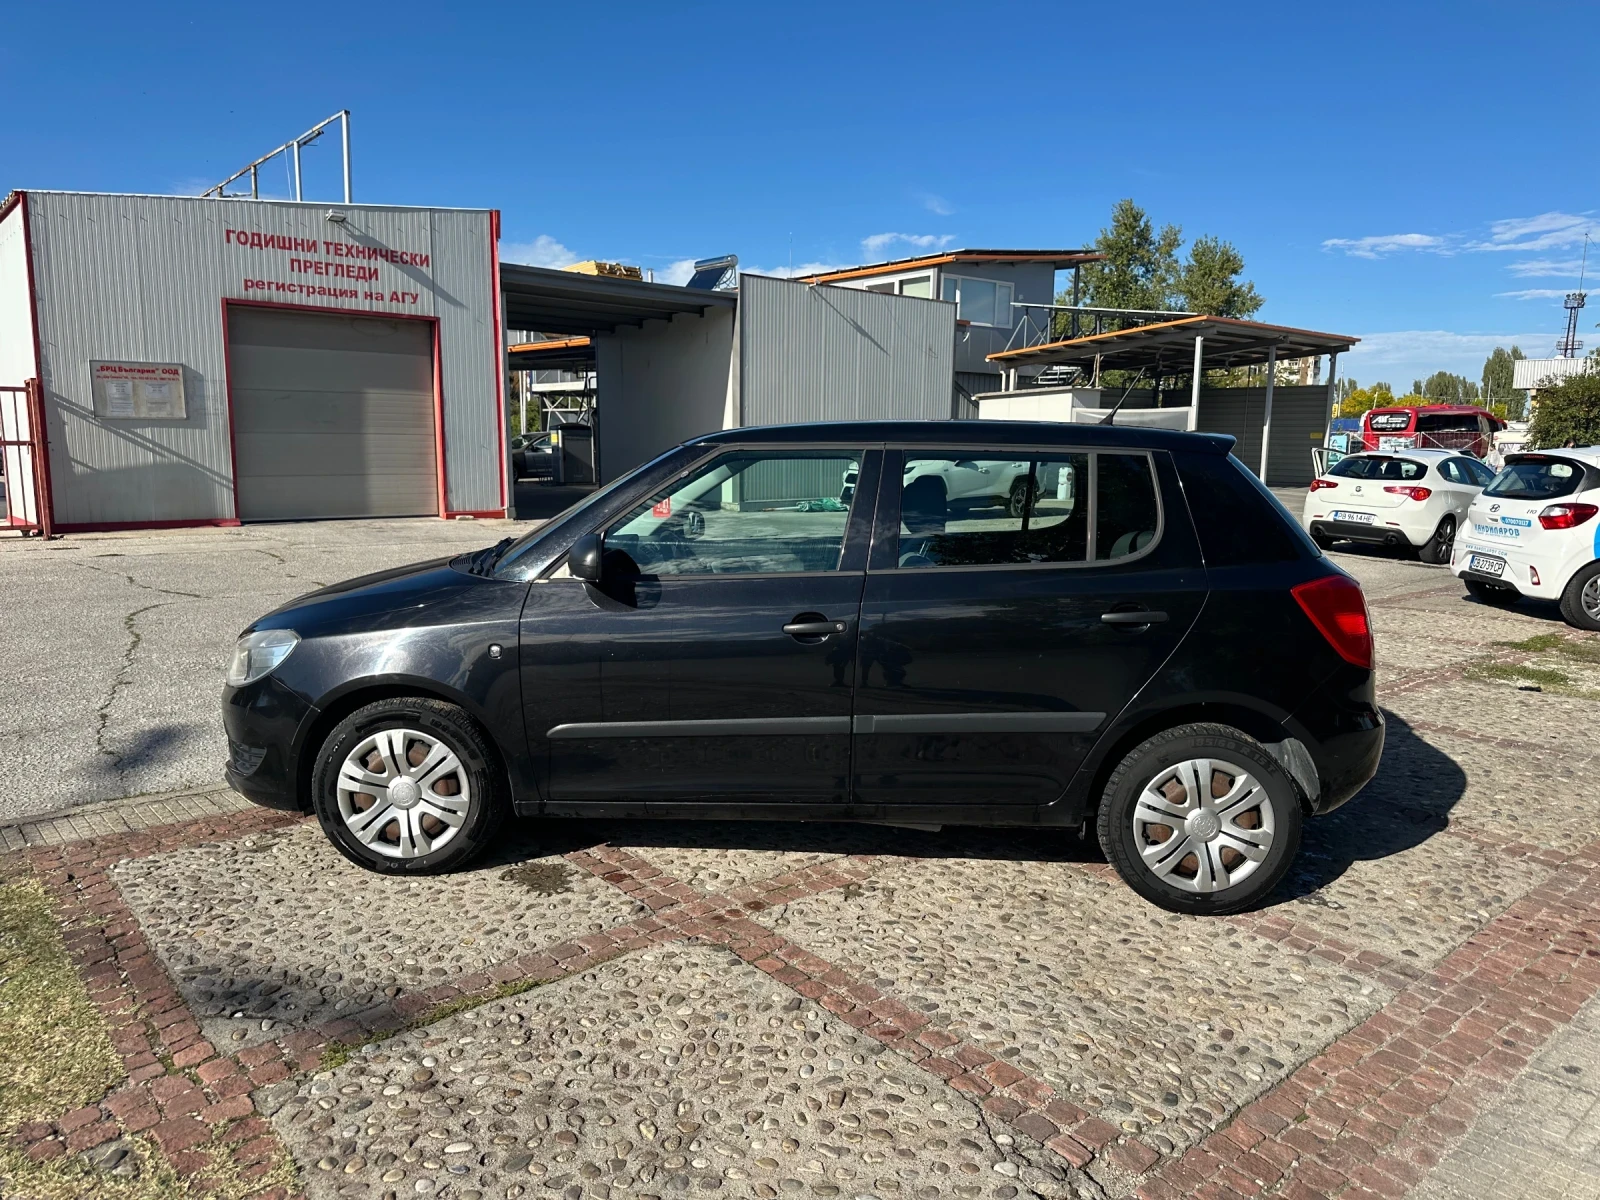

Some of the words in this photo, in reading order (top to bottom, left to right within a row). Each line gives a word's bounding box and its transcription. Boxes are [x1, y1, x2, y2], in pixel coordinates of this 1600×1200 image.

[225, 229, 318, 254] ГОДИШНИ
[323, 241, 430, 267] ТЕХНИЧЕСКИ
[290, 258, 379, 282] ПРЕГЛЕДИ
[243, 278, 358, 300] регистрация
[364, 291, 385, 301] на
[389, 291, 419, 304] АГУ
[162, 368, 179, 376] ООД
